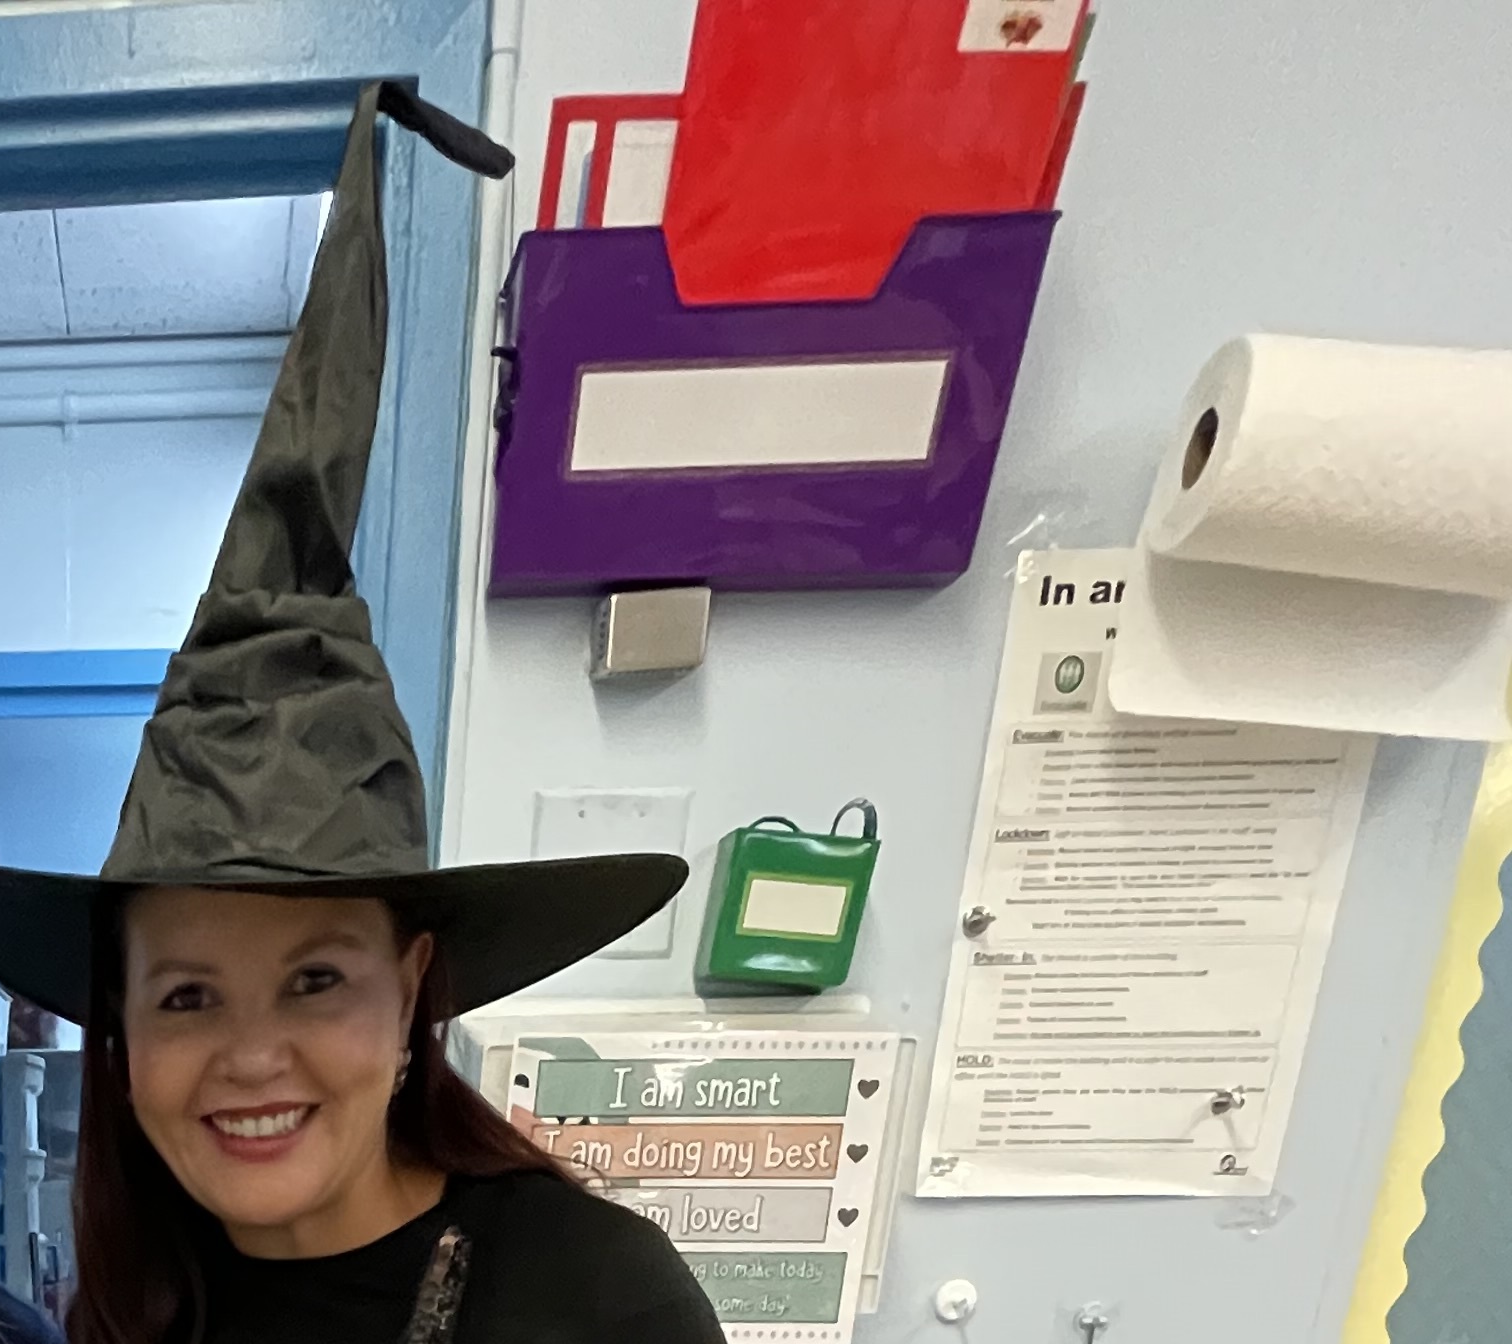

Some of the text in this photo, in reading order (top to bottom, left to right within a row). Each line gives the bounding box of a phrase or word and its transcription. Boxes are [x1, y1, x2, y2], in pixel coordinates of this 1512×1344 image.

[1039, 575, 1075, 606] In
[609, 1066, 782, 1109] I am smart
[571, 1139, 612, 1170] am
[623, 1131, 703, 1177] doing
[712, 1138, 755, 1178] my
[764, 1132, 832, 1169] best
[682, 1194, 763, 1234] loved
